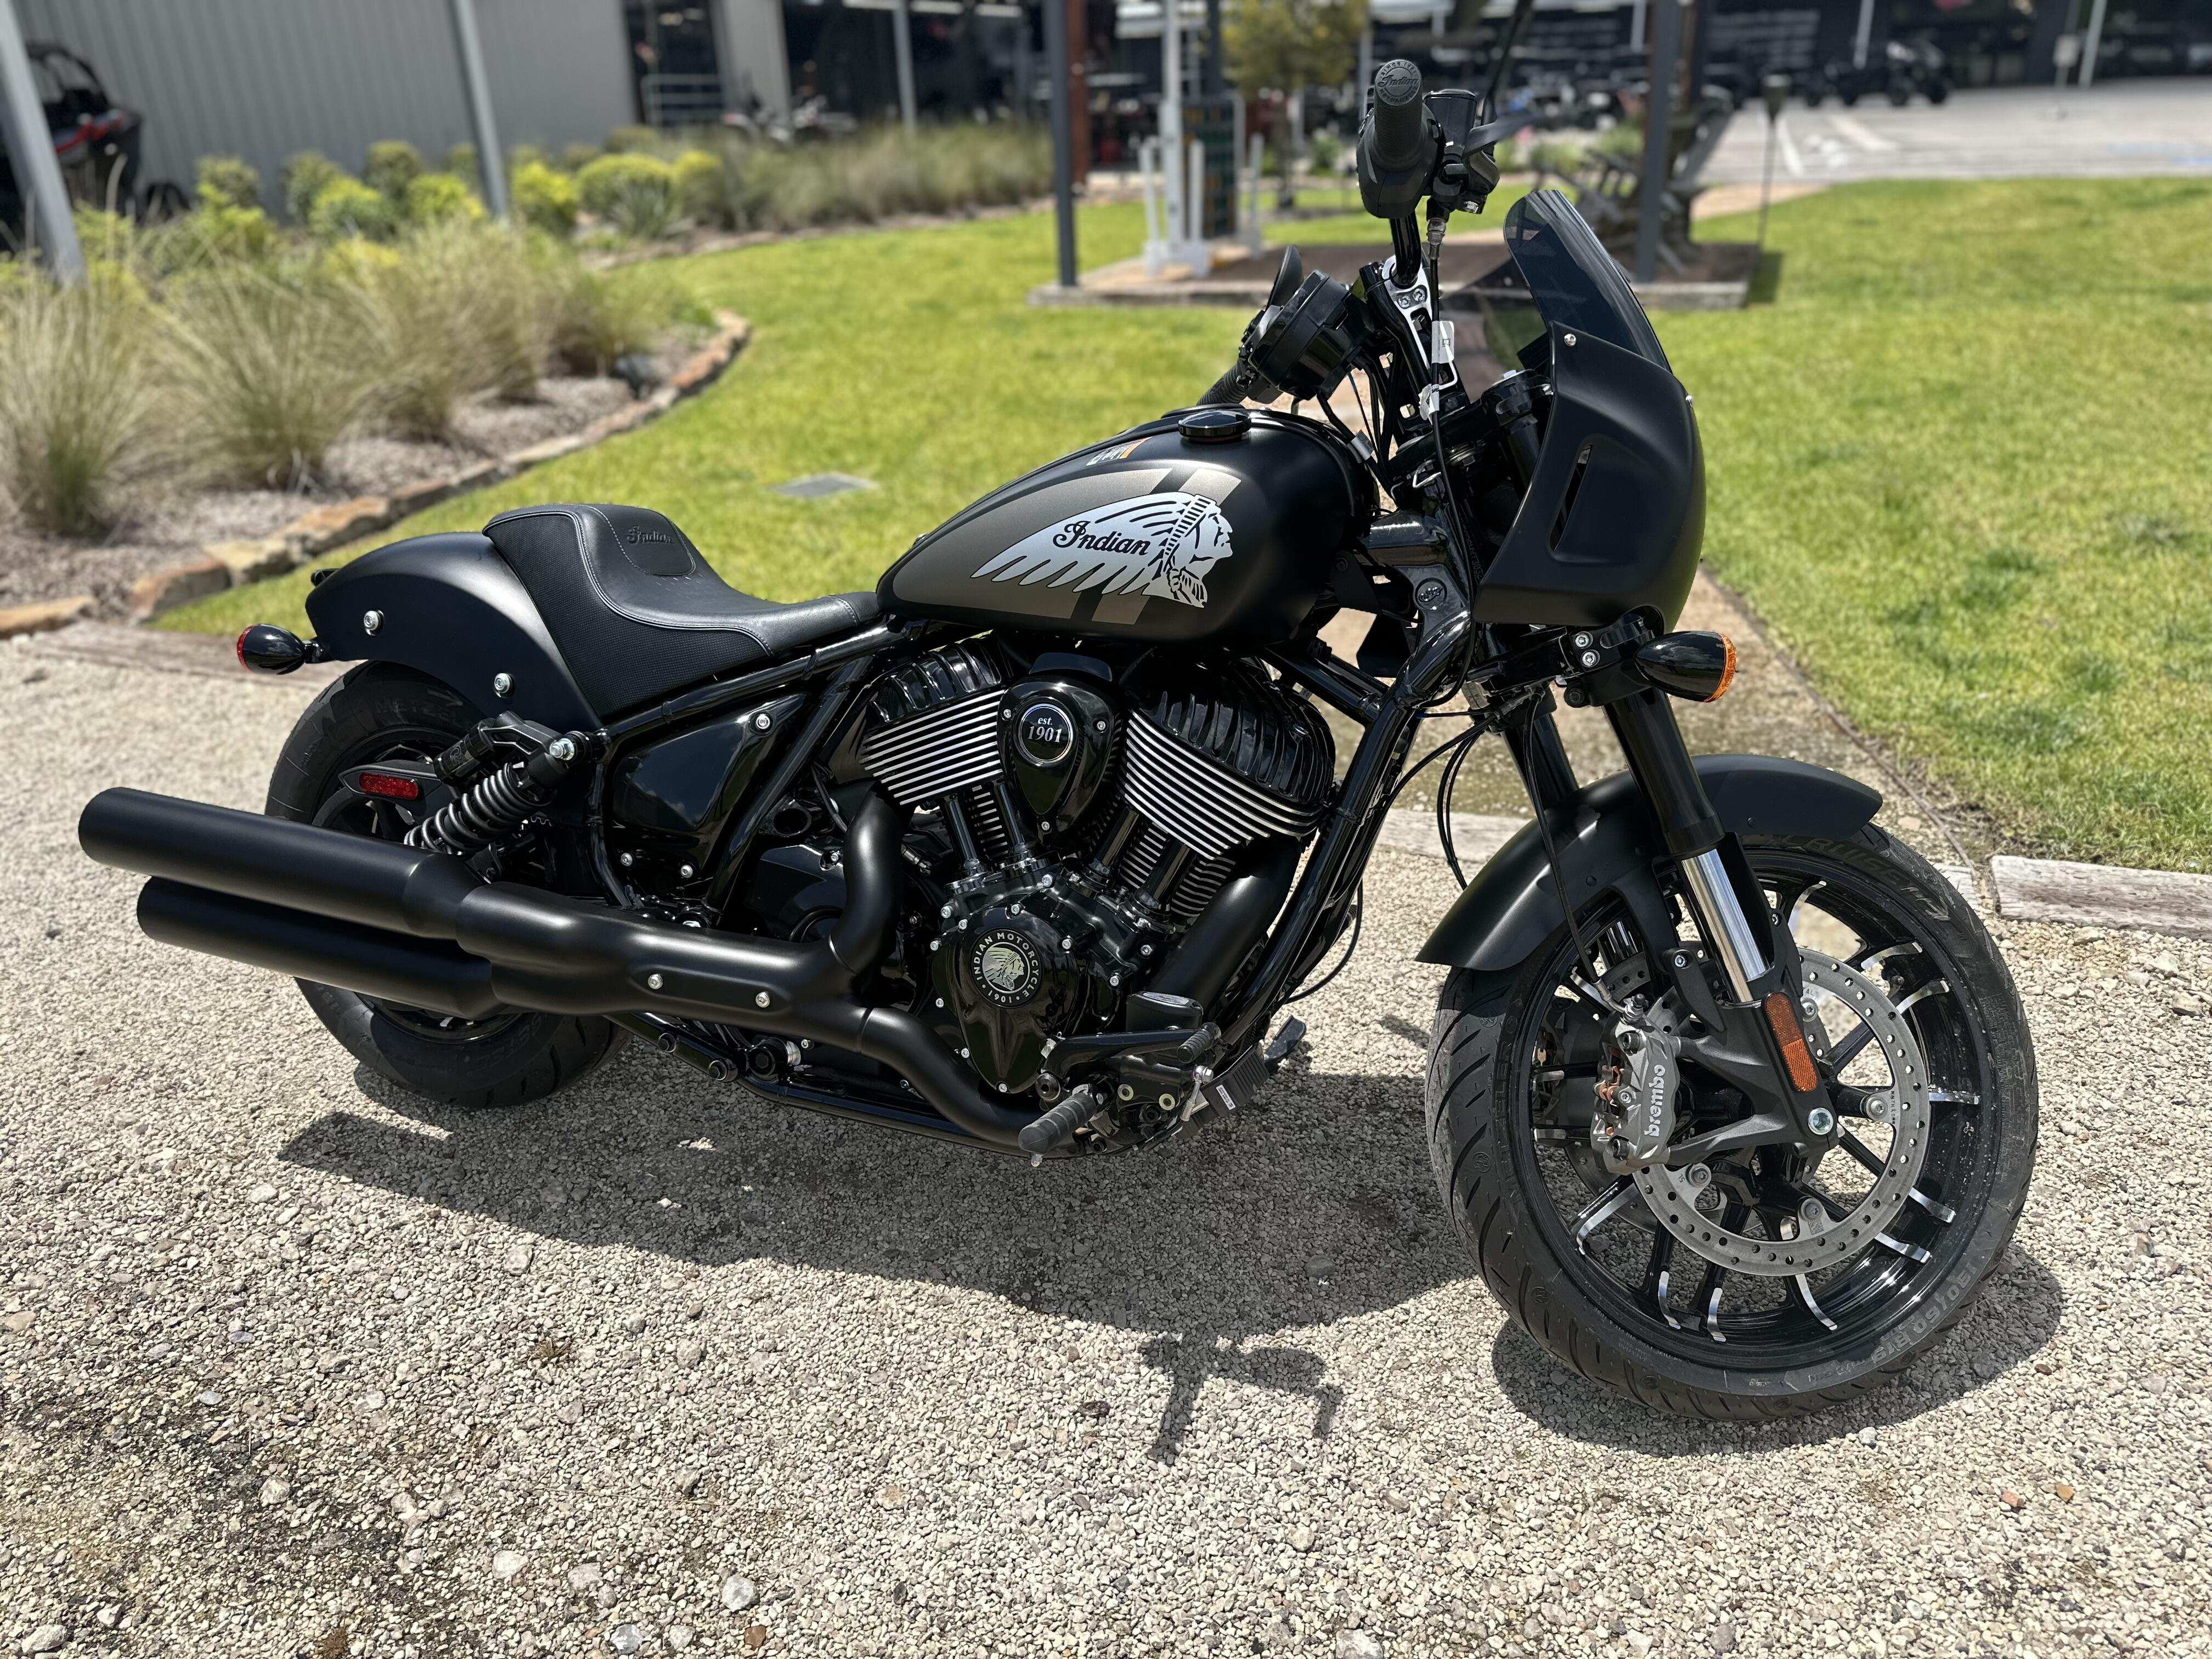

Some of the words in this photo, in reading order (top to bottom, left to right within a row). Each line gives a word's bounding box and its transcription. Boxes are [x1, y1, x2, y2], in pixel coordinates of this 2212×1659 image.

[1378, 75, 1419, 87] Indian
[626, 525, 675, 545] Indian
[1052, 521, 1152, 556] Indian
[1037, 716, 1053, 726] est.
[1027, 726, 1063, 743] 1901
[974, 935, 993, 980] INDIAN
[997, 932, 1040, 997] MOTORCYCLE
[988, 990, 1012, 1003] 1901
[1644, 1064, 1666, 1137] brembo
